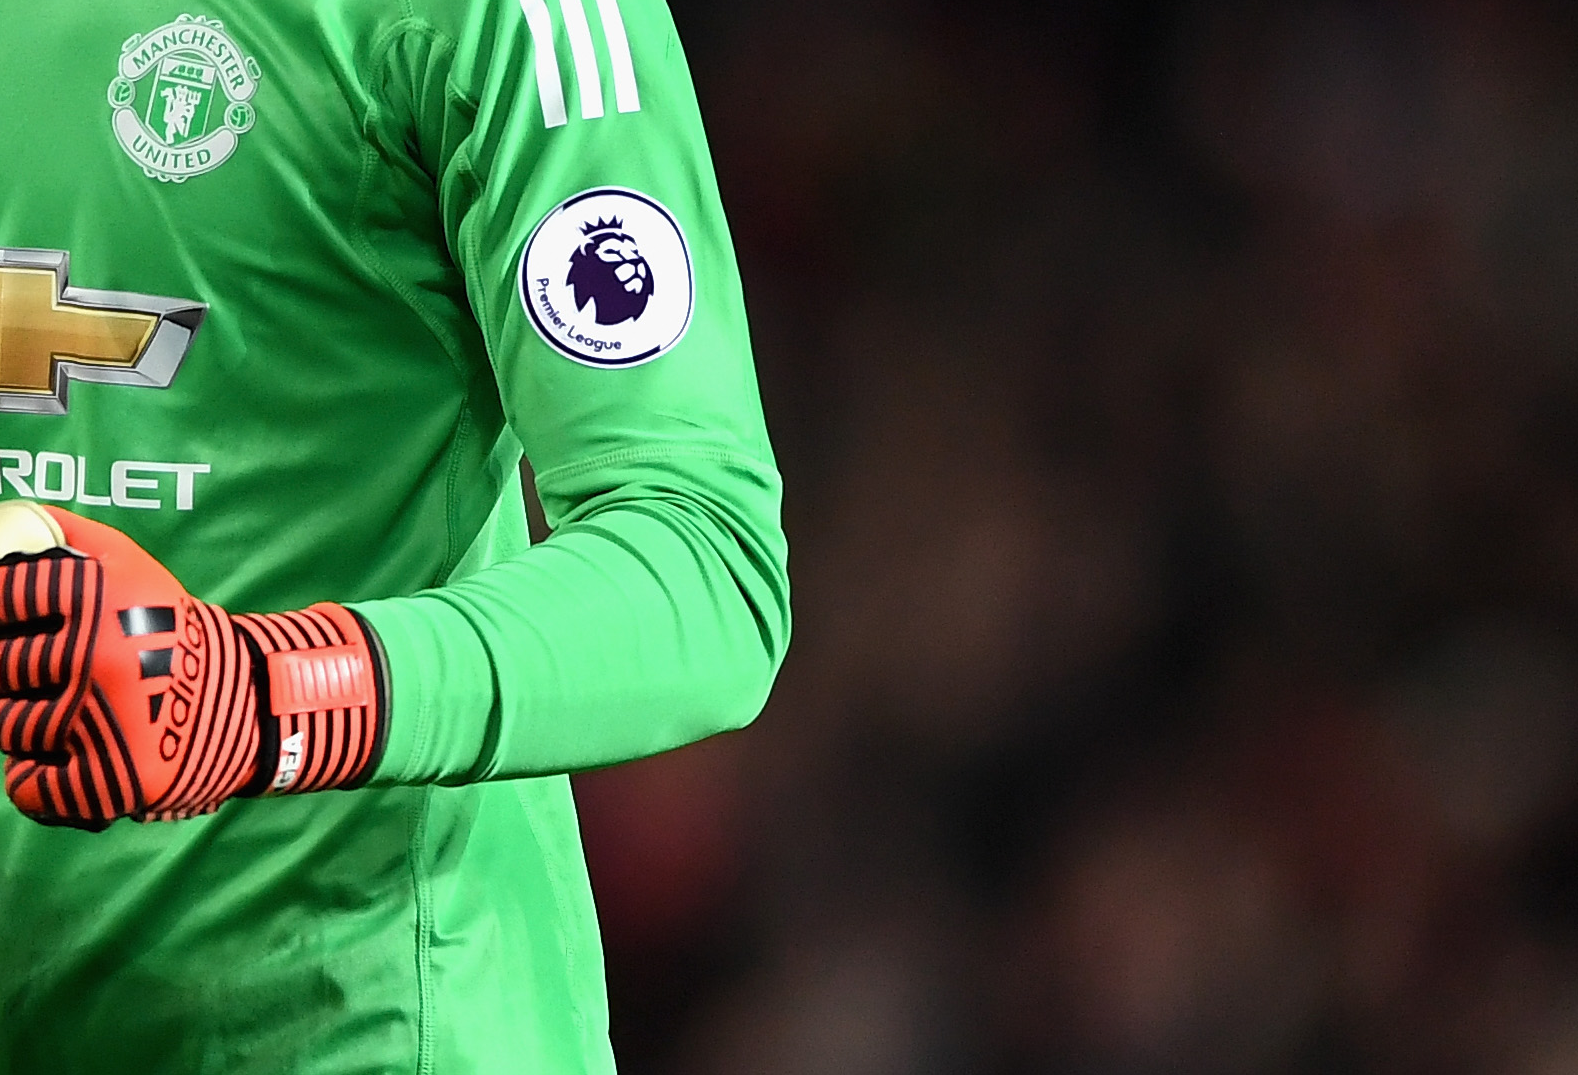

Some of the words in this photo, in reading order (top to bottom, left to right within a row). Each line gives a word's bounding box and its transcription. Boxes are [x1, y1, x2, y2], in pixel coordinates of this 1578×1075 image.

[132, 29, 246, 91] MANCHESTER
[132, 135, 212, 169] UNITED
[536, 277, 567, 329] Premier
[567, 325, 622, 352] League
